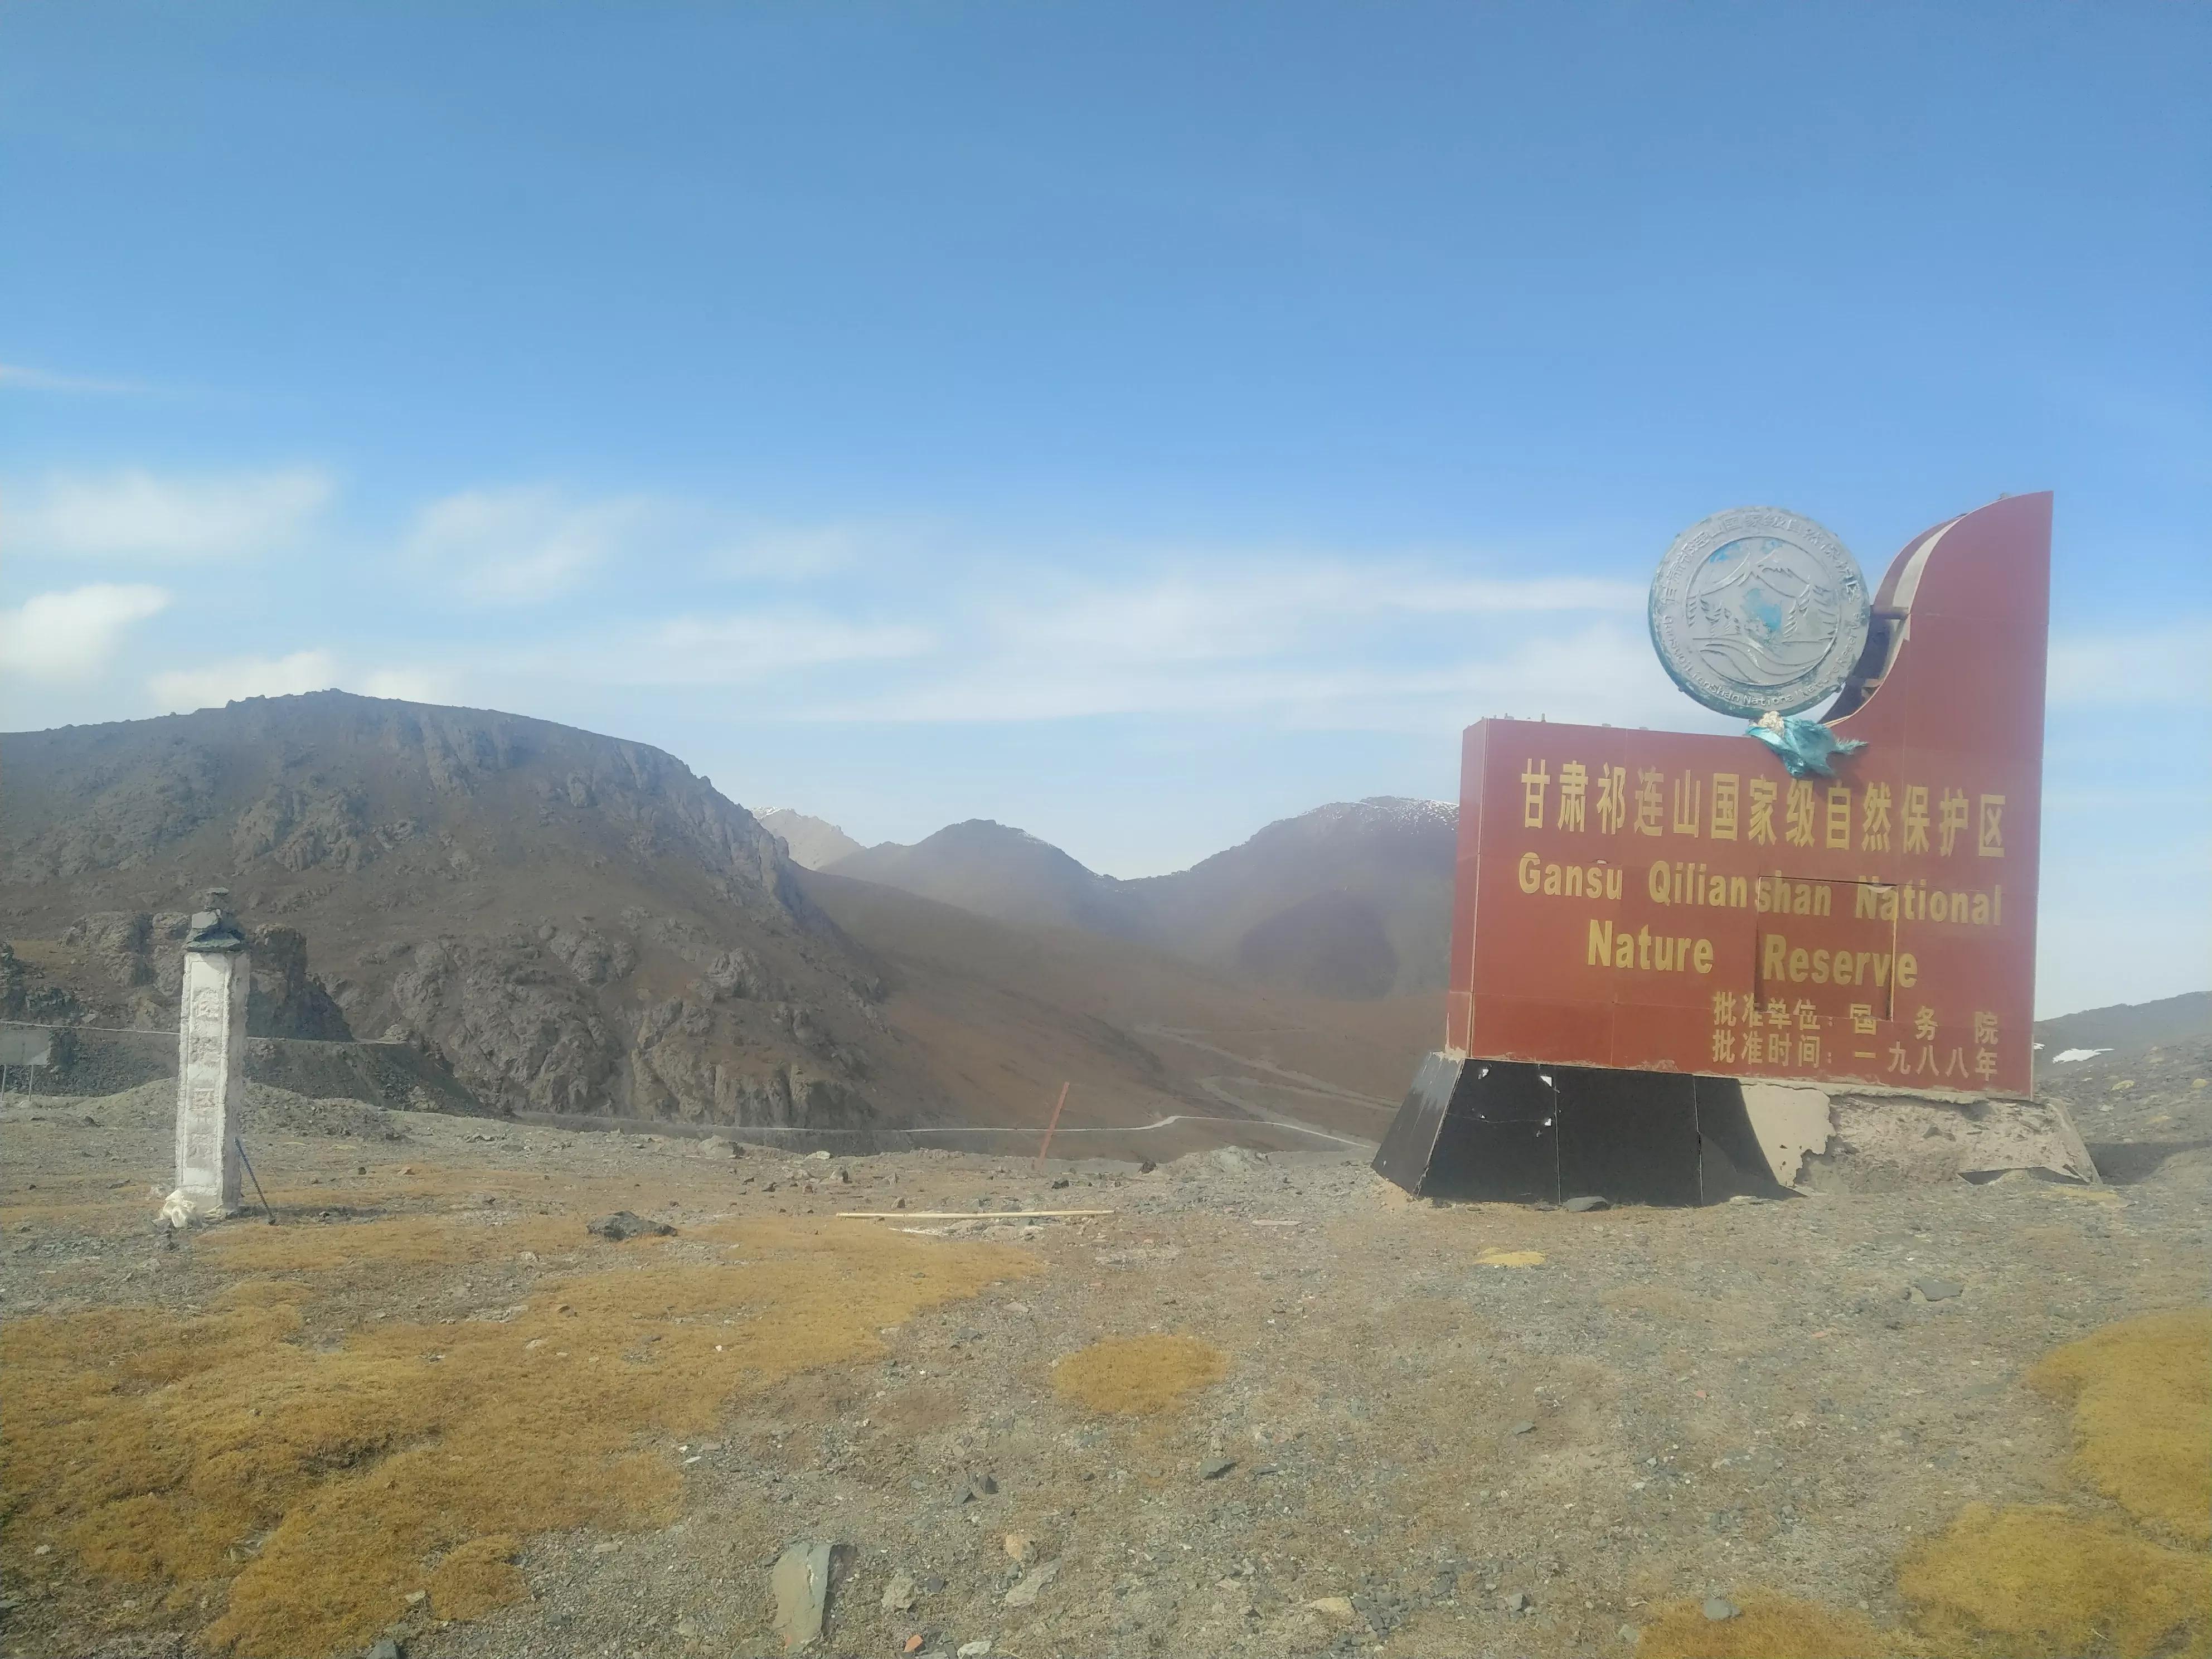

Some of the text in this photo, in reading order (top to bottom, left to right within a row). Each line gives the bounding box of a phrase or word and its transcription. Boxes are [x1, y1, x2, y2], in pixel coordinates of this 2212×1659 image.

[1521, 758, 2006, 858] 甘肃祁连山国家级自然保护区
[1519, 852, 2002, 926] Gansu Qilianshan National
[1588, 919, 1918, 988] Nature Reserve
